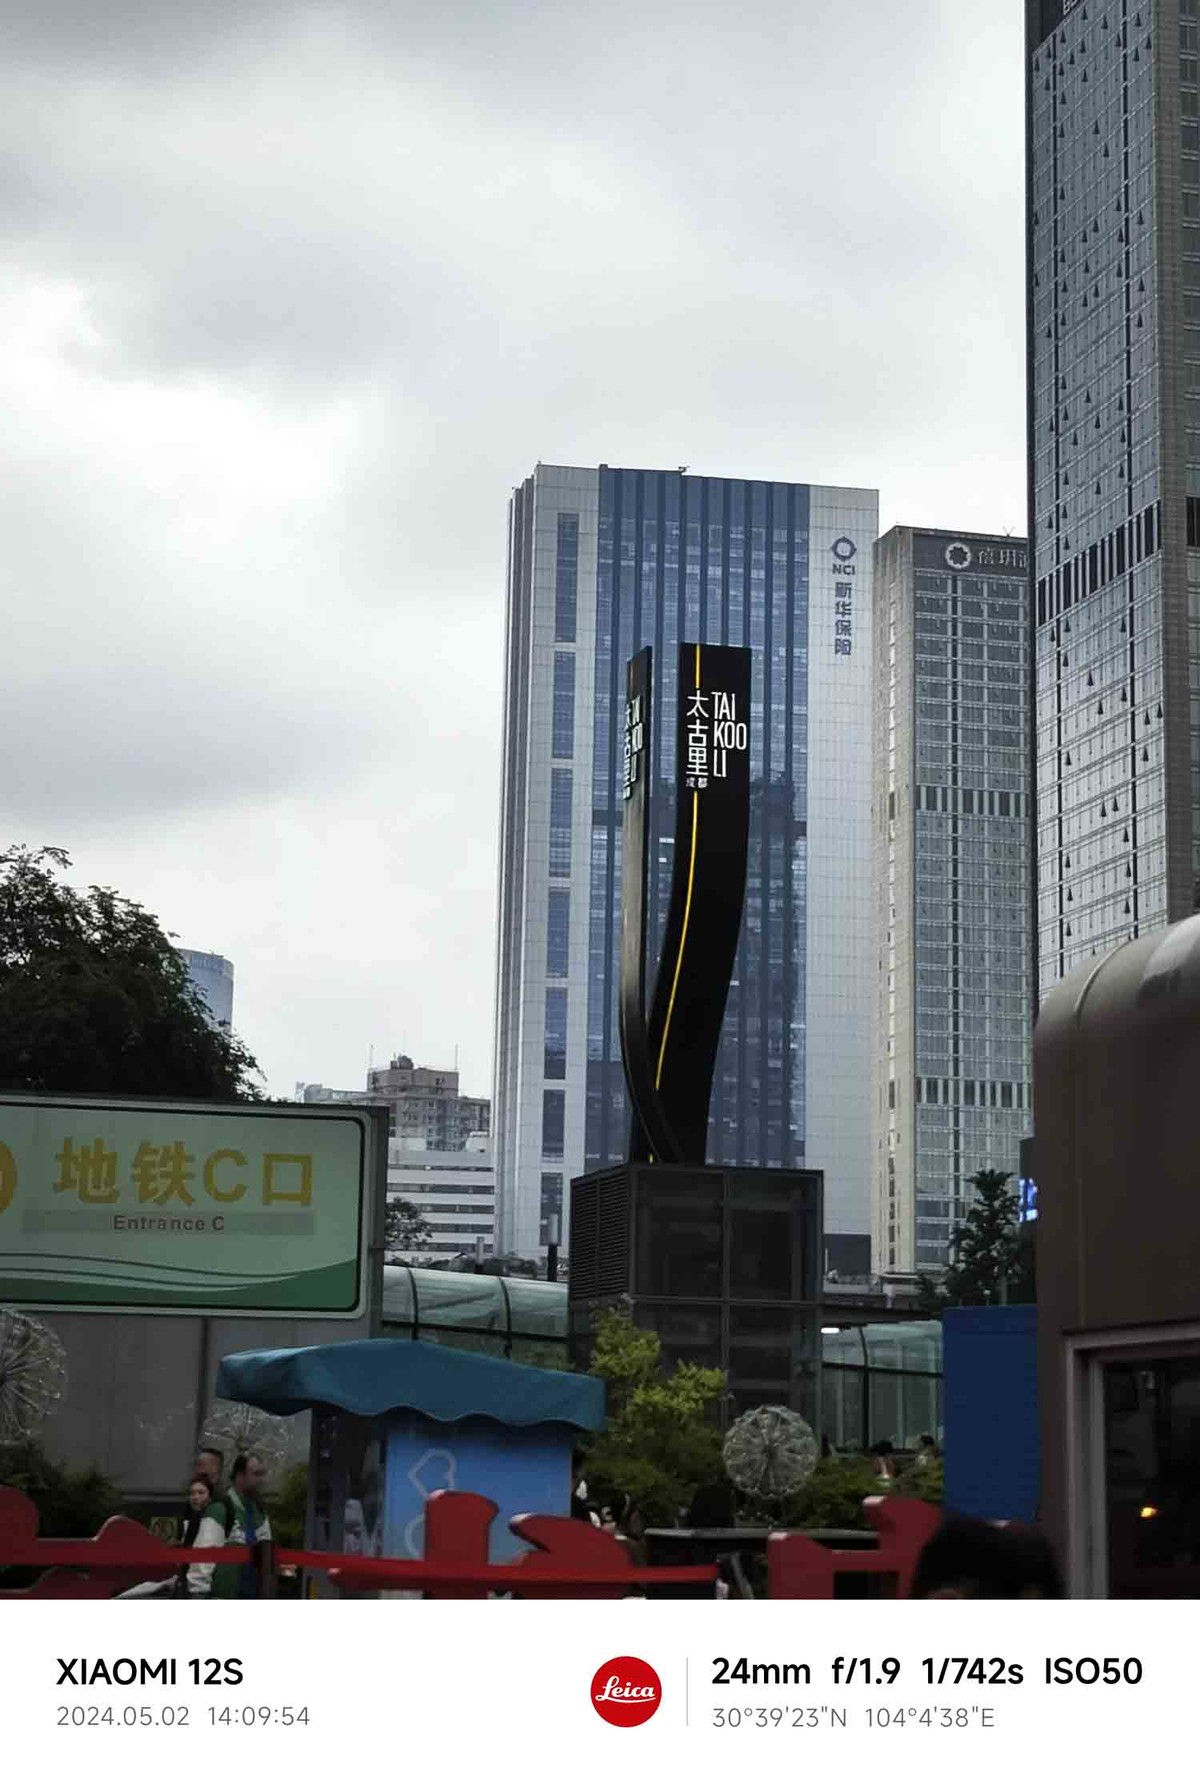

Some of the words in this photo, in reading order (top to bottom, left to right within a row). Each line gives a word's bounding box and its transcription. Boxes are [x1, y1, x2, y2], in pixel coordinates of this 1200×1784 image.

[832, 564, 856, 576] NCI
[834, 581, 852, 656] 新华保险
[711, 691, 736, 721] TAI
[686, 690, 709, 776] 太古里
[713, 721, 747, 750] KOO
[713, 750, 727, 778] LI
[686, 777, 708, 789] 成都
[53, 1137, 315, 1207] 地铁C口
[113, 1214, 206, 1232] Entrance
[211, 1215, 225, 1231] C
